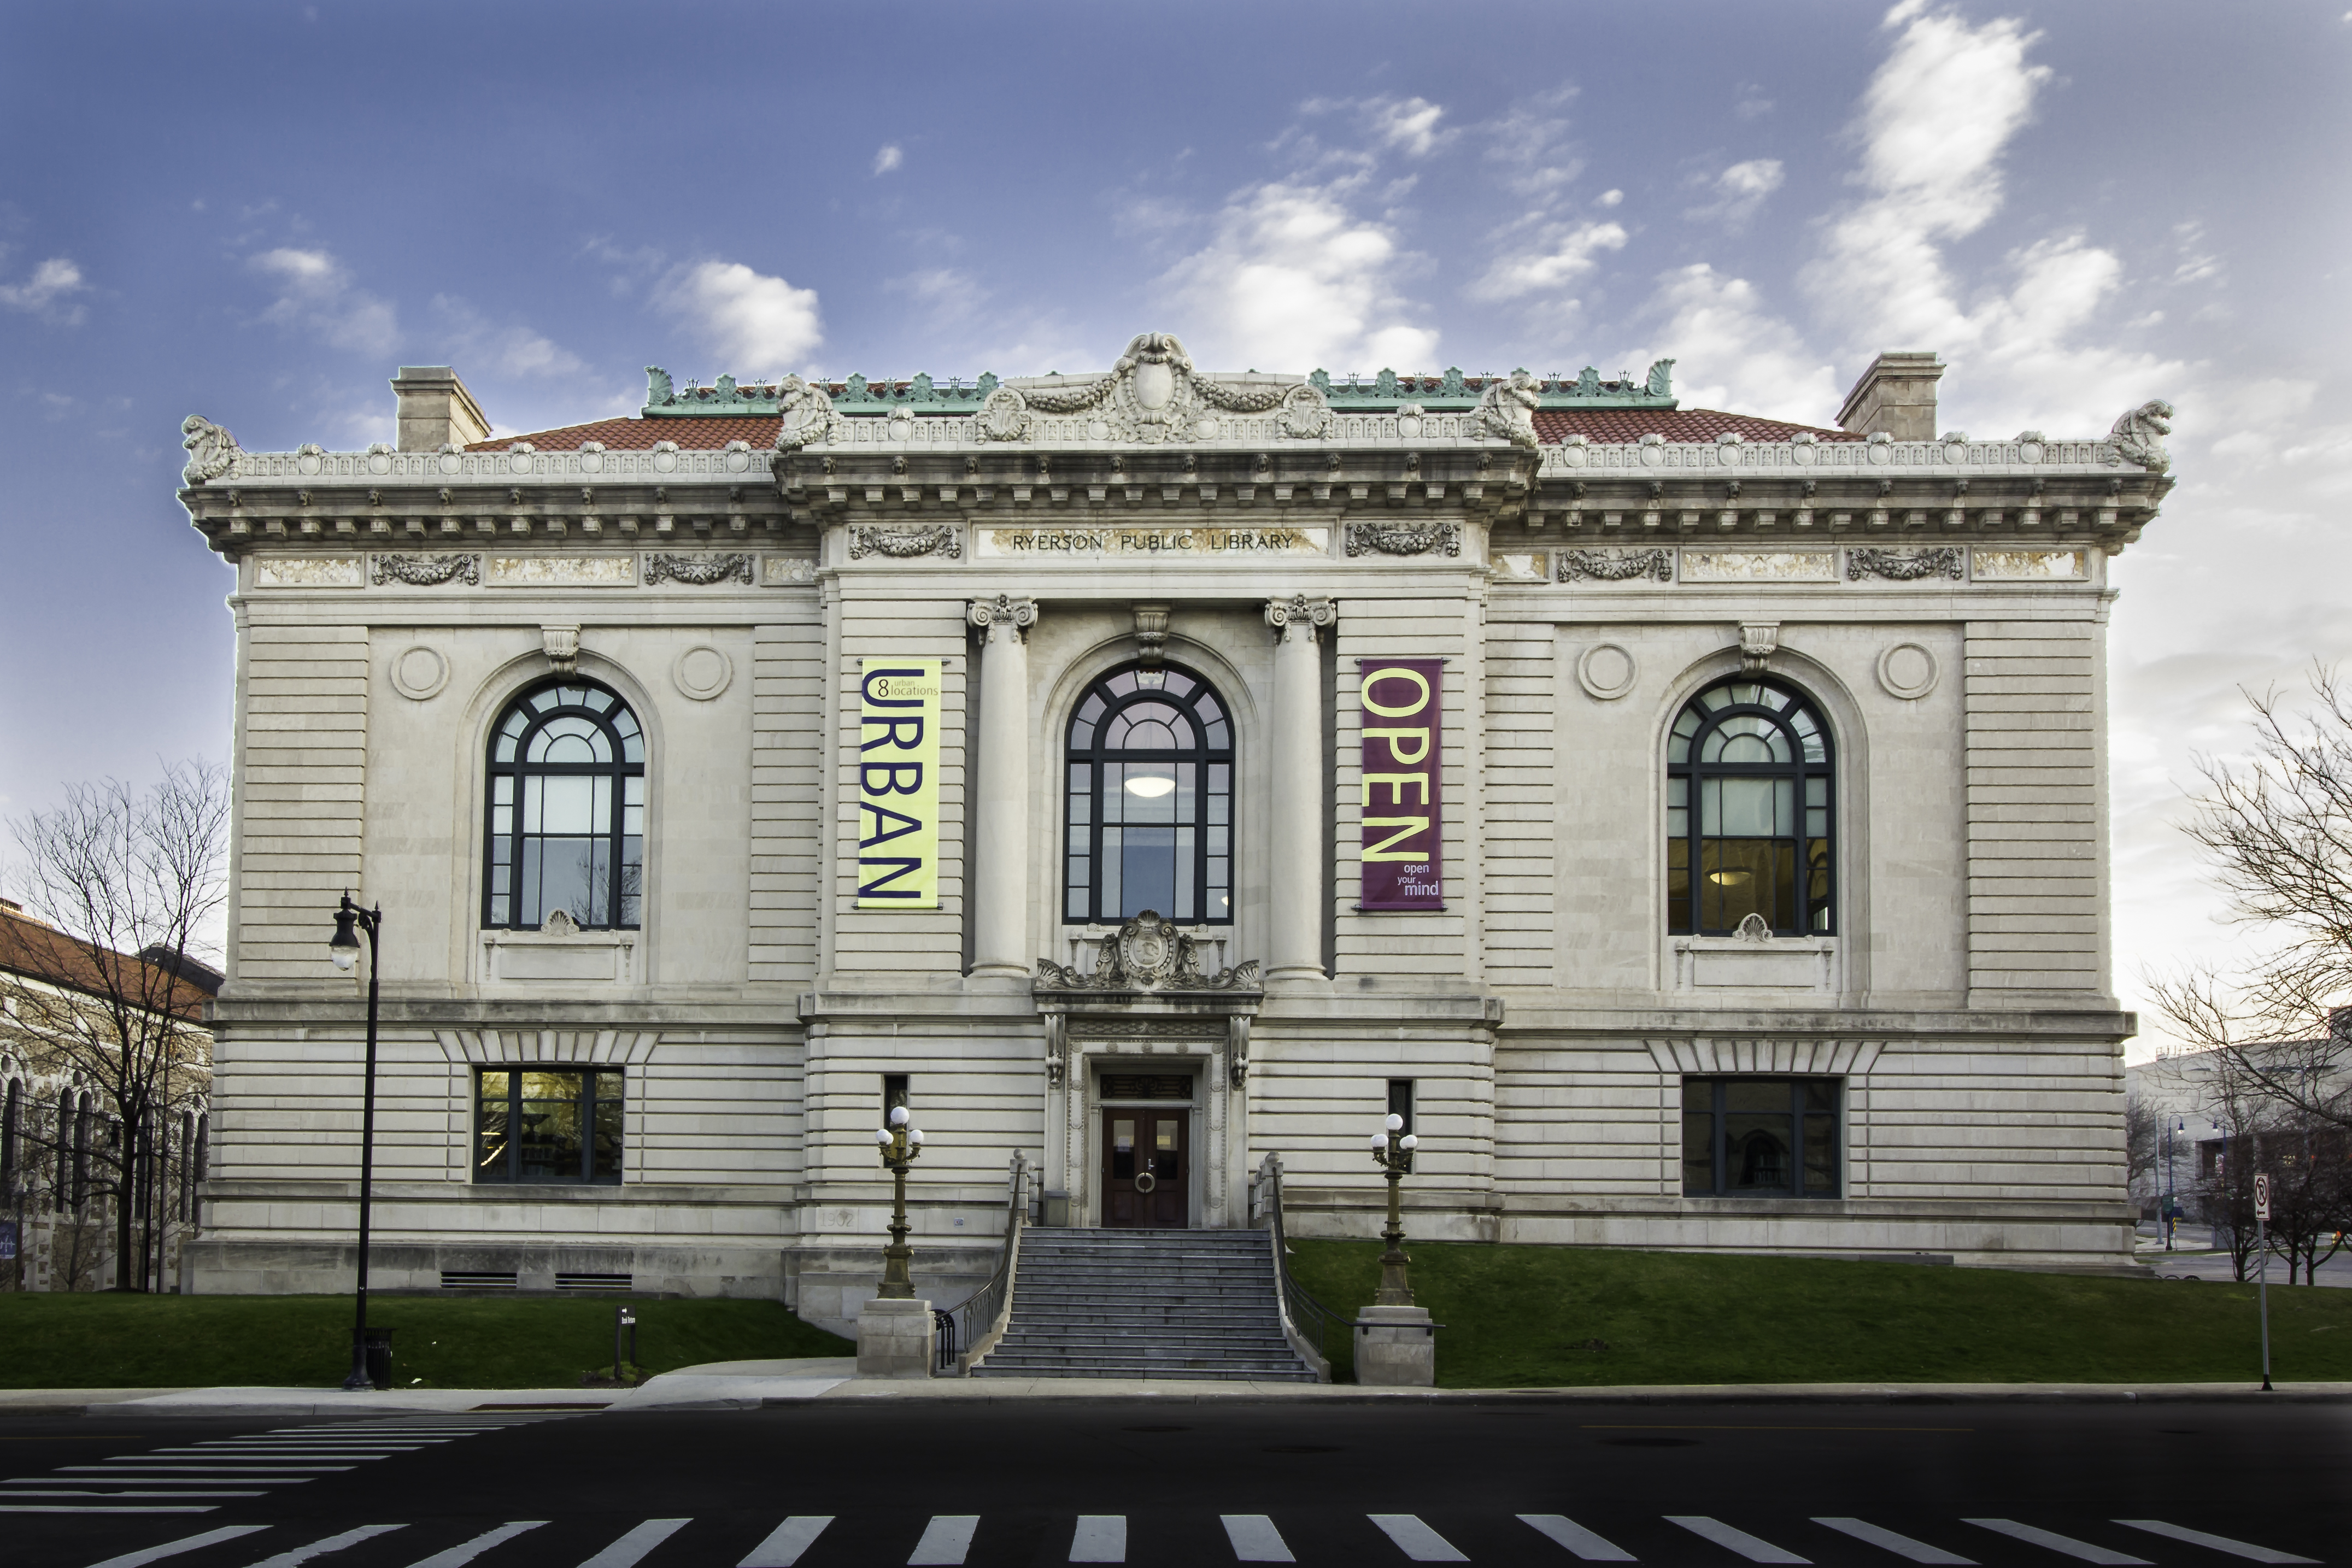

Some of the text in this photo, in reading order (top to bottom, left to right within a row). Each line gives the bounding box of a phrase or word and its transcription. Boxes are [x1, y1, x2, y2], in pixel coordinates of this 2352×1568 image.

[1013, 533, 1295, 550] RYERSON PUBLIC LIBRARY
[878, 679, 889, 697] 8
[891, 684, 939, 696] locations
[1362, 667, 1430, 862] OPEN
[858, 669, 925, 898] URBAN
[1404, 865, 1429, 876] open
[1397, 877, 1416, 885] your
[1405, 880, 1439, 896] mind
[820, 1213, 854, 1227] 1902
